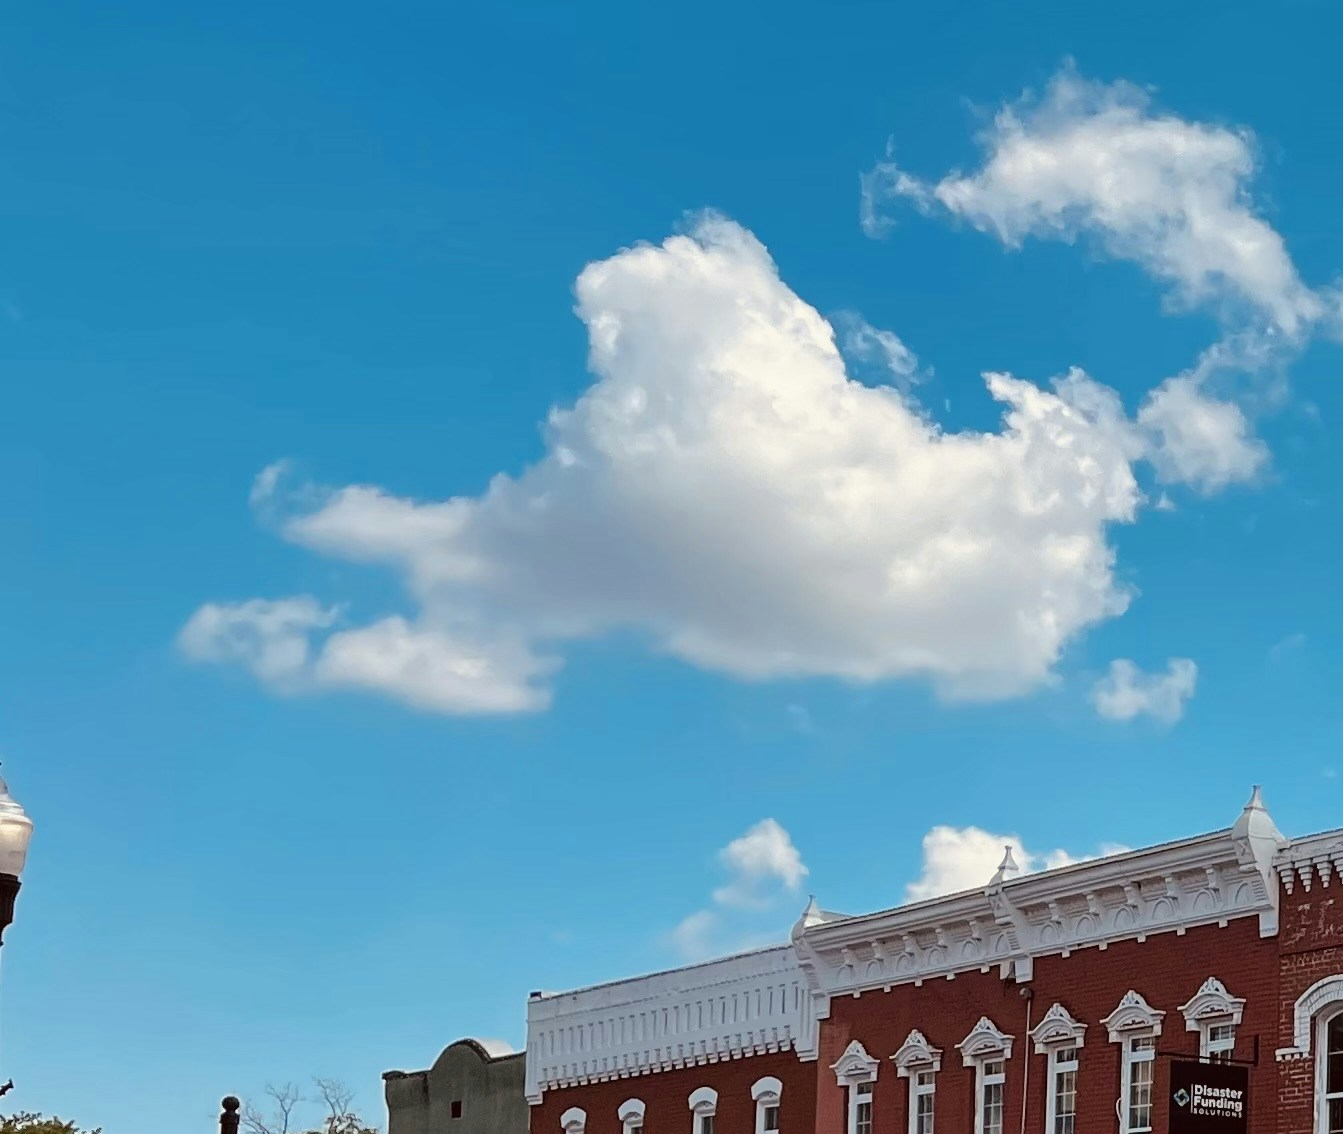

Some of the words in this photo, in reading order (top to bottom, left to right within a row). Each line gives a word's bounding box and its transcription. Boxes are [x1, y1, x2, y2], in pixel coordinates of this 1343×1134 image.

[1194, 1084, 1243, 1099] Disaster
[1194, 1096, 1243, 1112] Funding
[1193, 1107, 1242, 1118] SOLUTIONS
